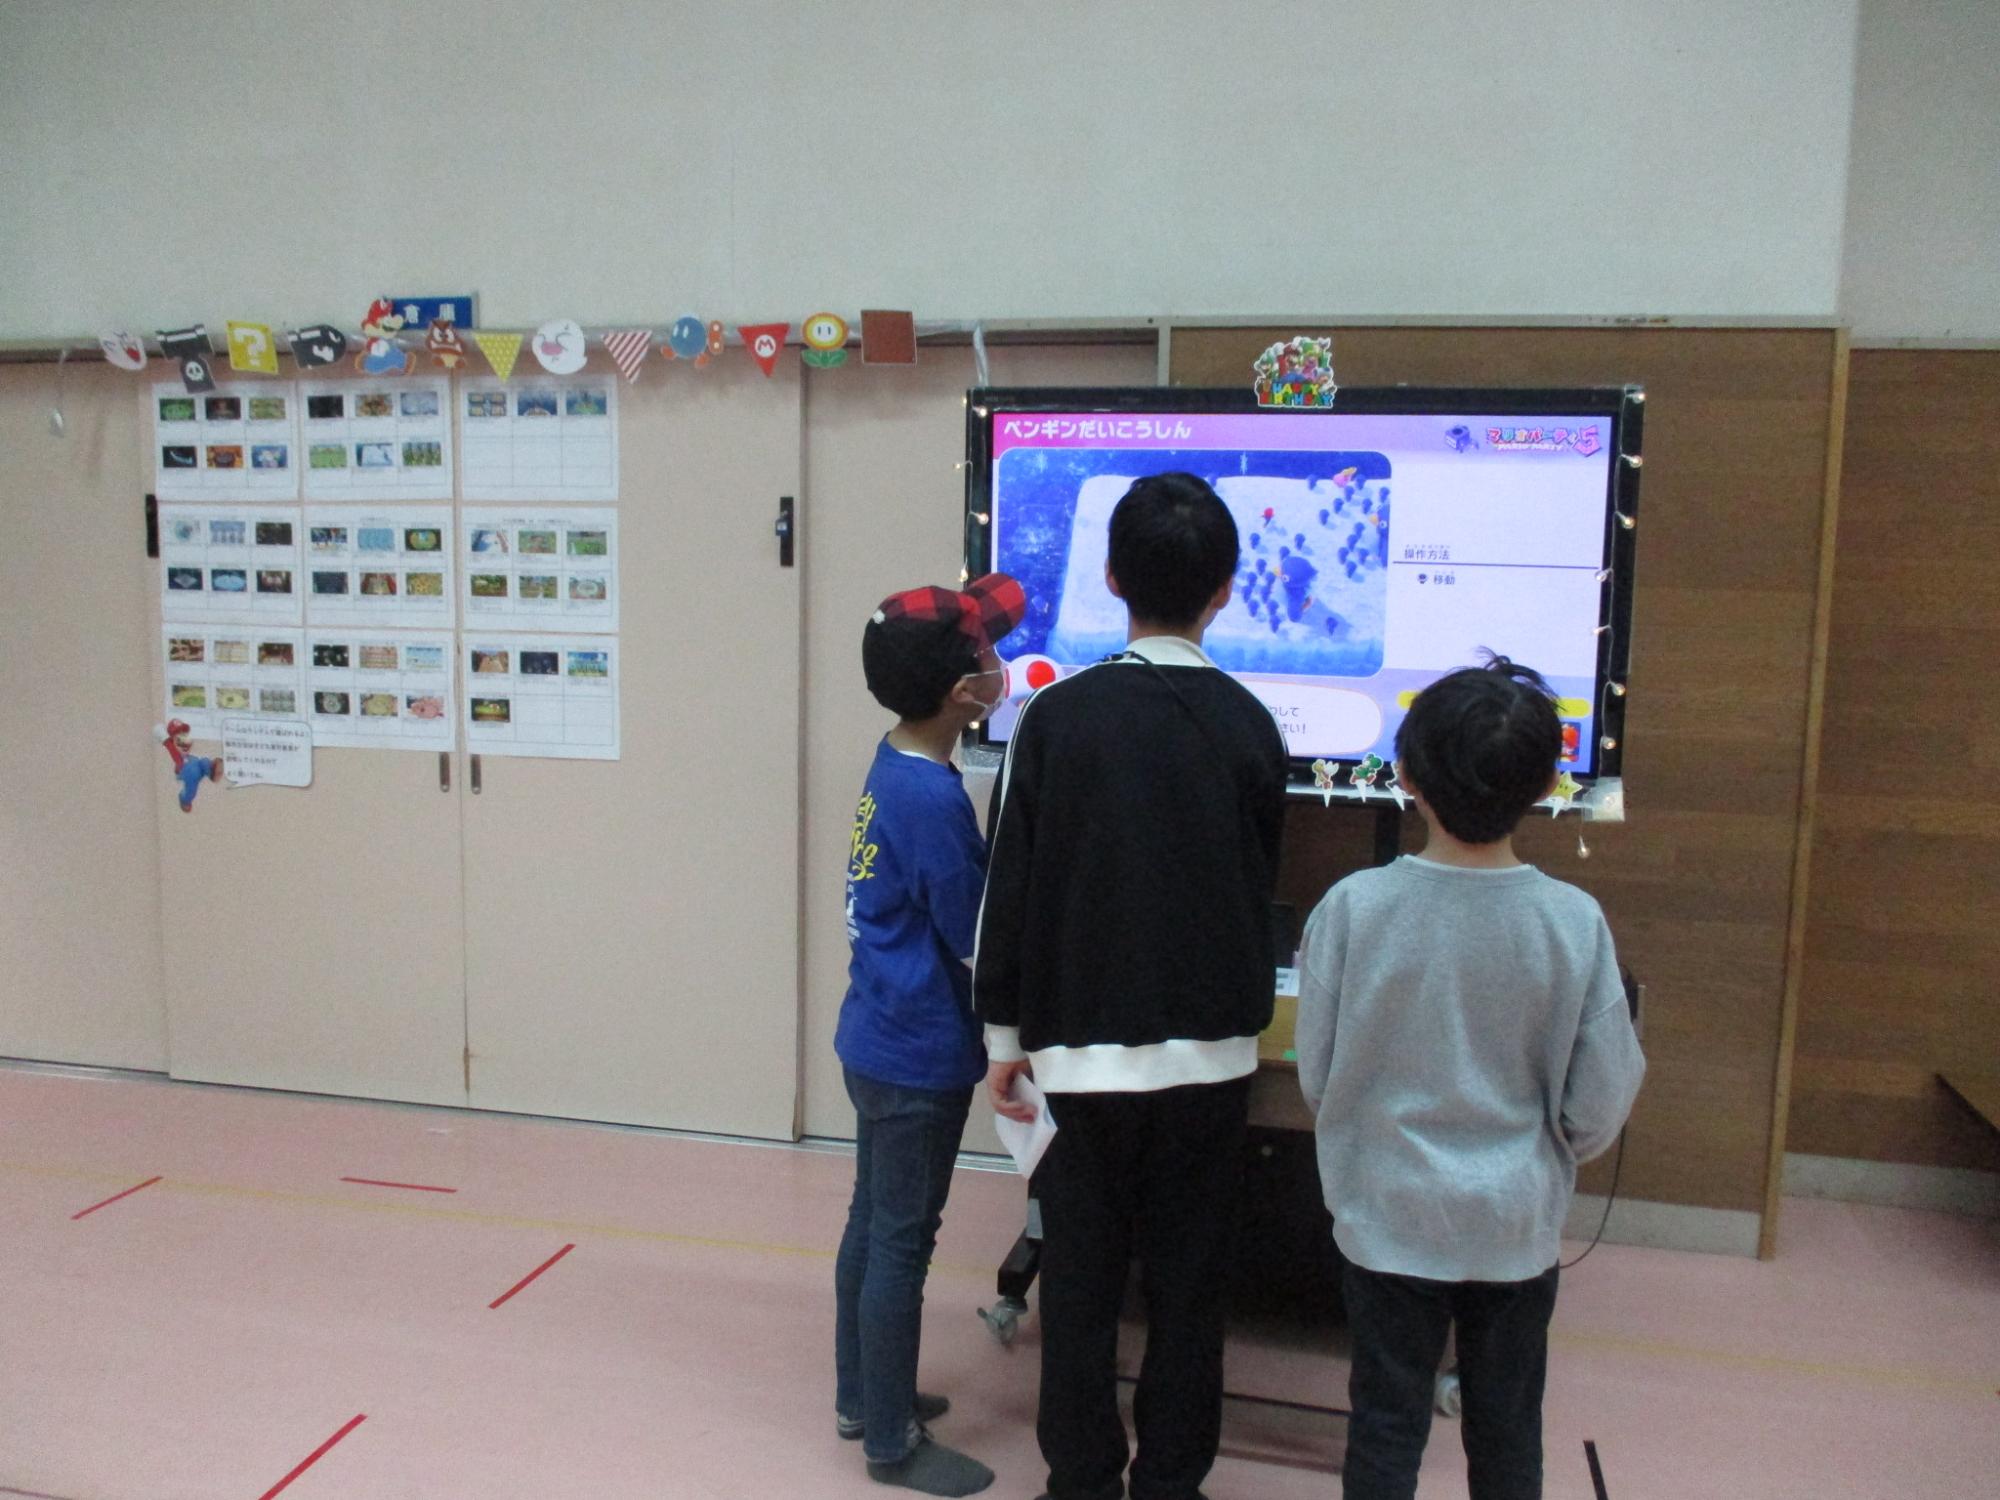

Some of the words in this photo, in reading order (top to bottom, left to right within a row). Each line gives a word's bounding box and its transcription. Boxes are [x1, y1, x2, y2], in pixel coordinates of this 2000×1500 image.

[1003, 419, 1192, 440] ペンギンだいこうしん
[1404, 548, 1451, 561] 操作方法
[1433, 574, 1456, 585] 移動
